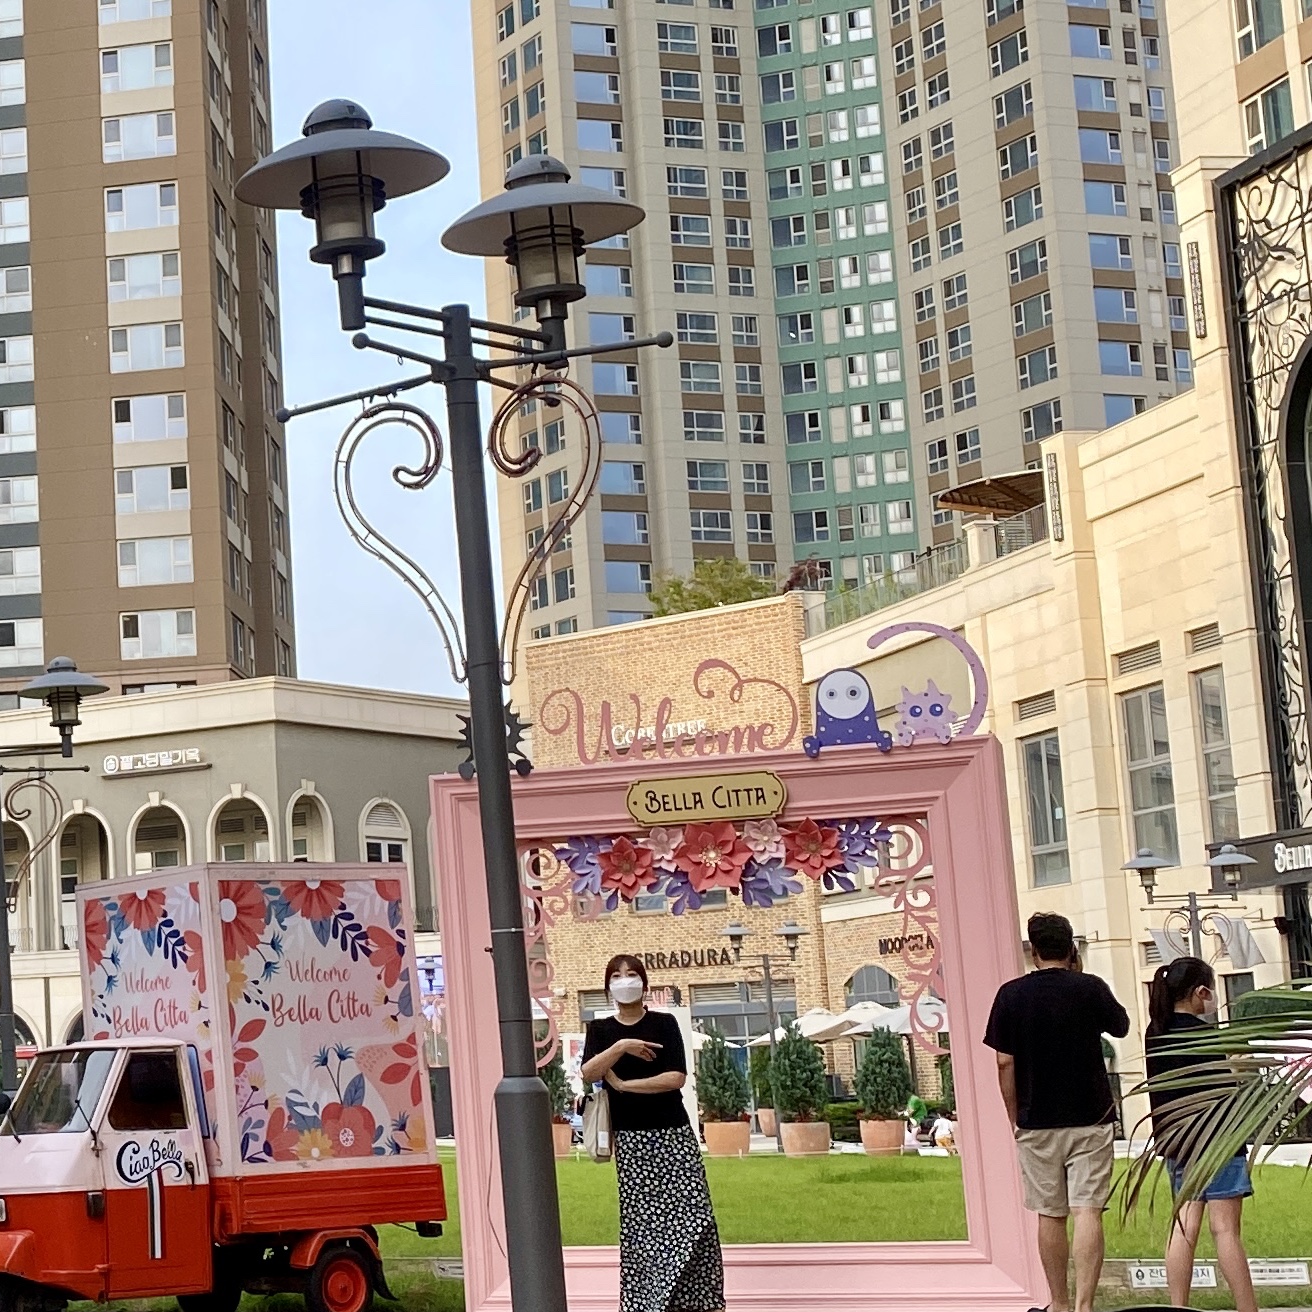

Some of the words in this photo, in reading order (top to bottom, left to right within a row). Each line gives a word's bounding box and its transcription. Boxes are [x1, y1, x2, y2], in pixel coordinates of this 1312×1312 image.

[540, 658, 798, 765] Welcome
[645, 789, 705, 814] BELLA
[712, 785, 767, 809] CITTA
[122, 967, 172, 994] Welcome
[285, 957, 352, 983] Welcome
[113, 1005, 150, 1038] Bella
[154, 998, 188, 1033] Citta
[271, 992, 322, 1027] Bella
[328, 989, 372, 1024] Citta
[116, 1140, 149, 1183] Ciao
[149, 1138, 183, 1170] Bella
